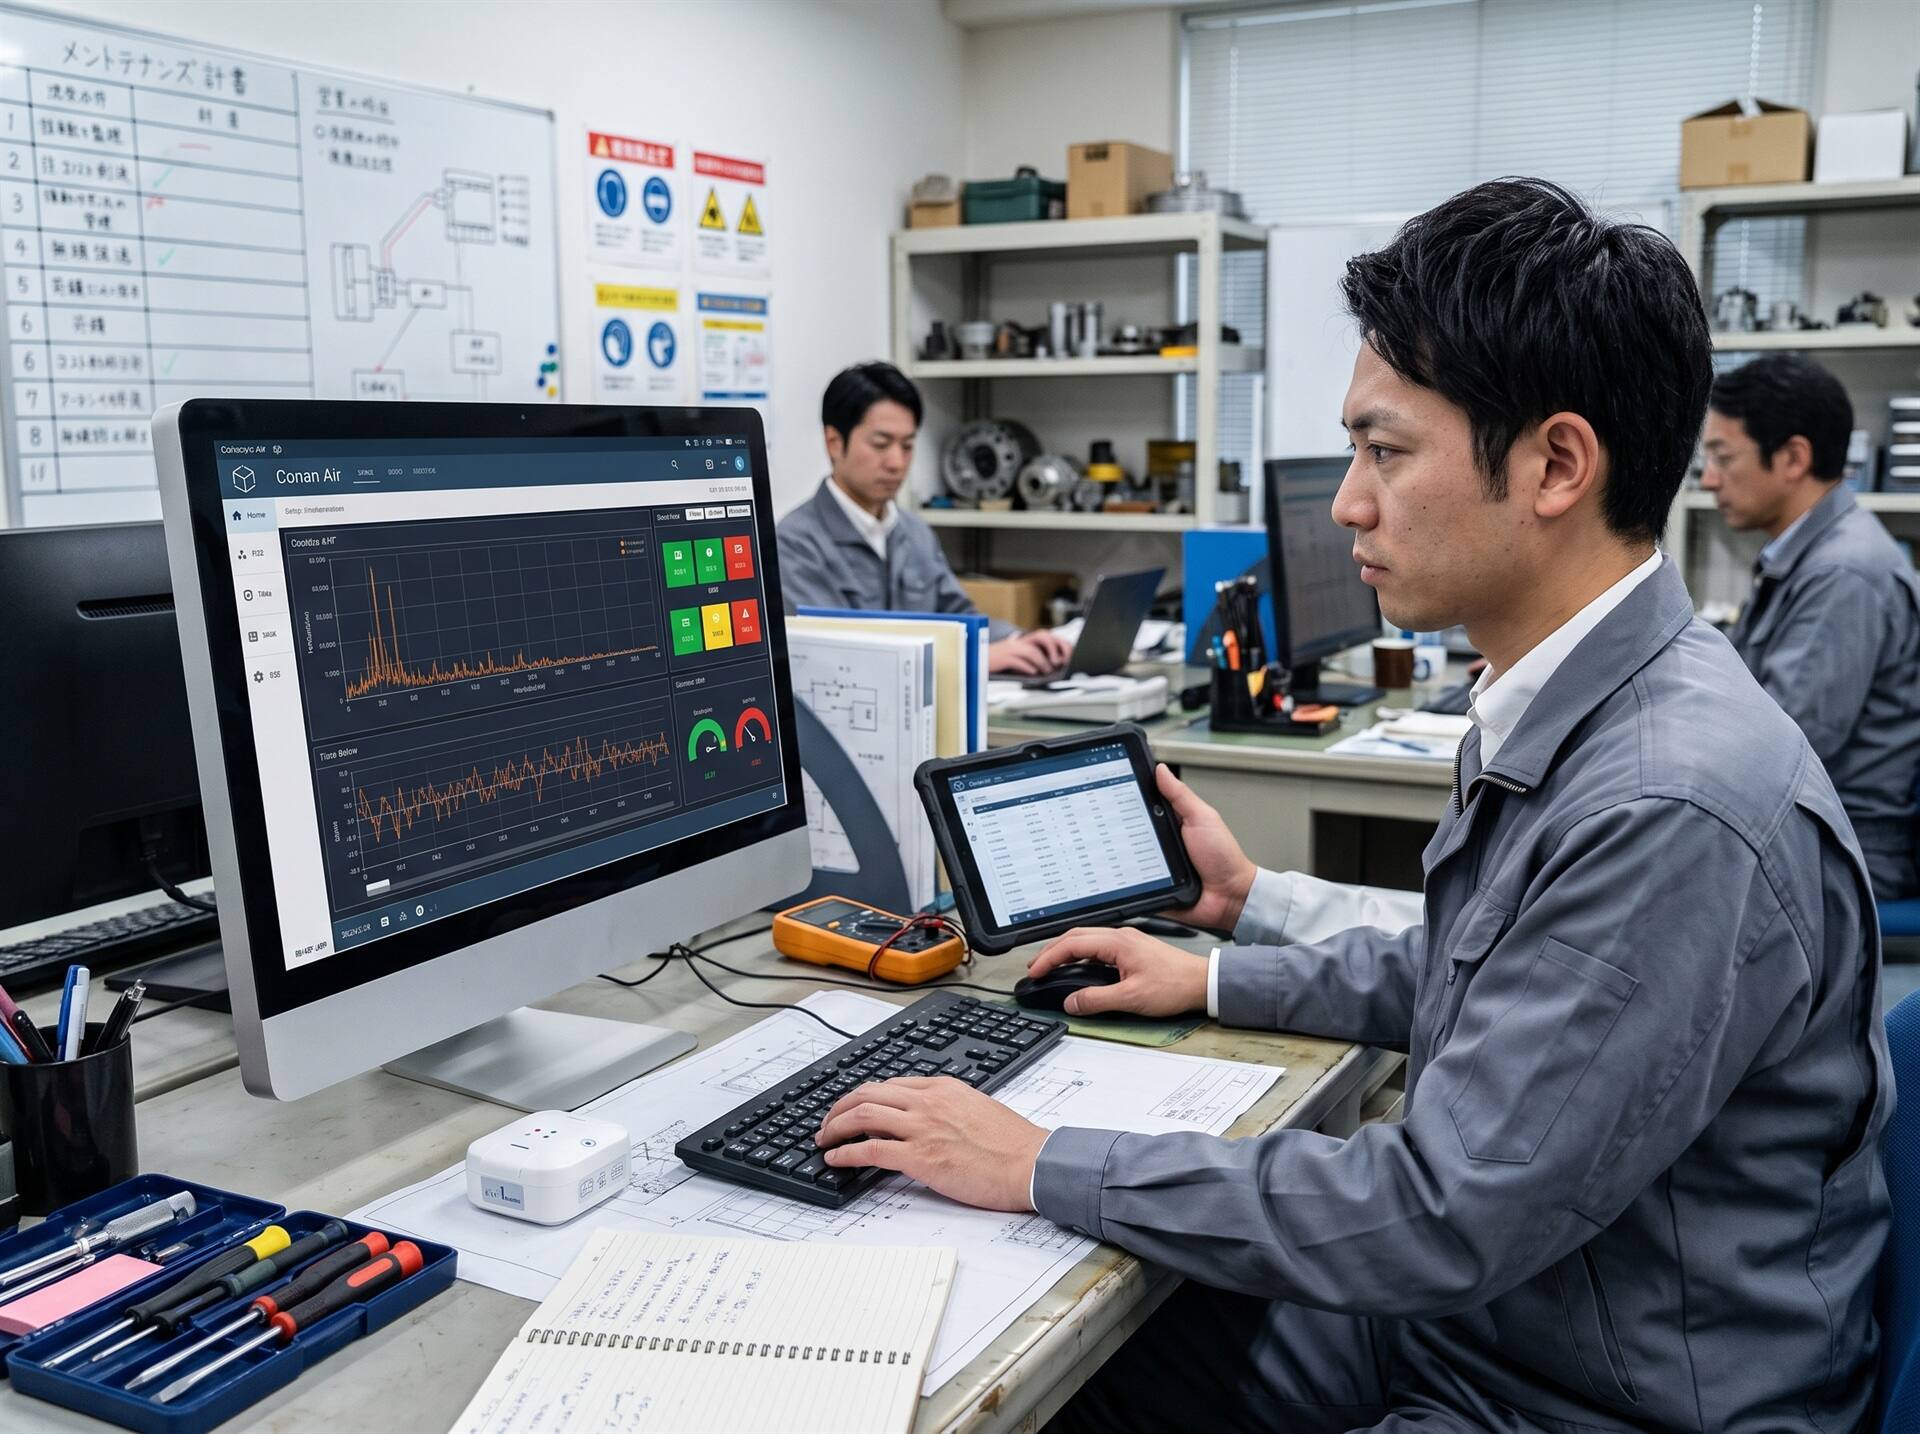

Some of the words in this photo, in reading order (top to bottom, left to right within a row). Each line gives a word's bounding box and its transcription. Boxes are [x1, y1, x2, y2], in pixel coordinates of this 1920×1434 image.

[10, 152, 20, 170] 2
[13, 194, 23, 213] 3
[18, 278, 28, 294] 5
[21, 315, 32, 333] 6
[24, 353, 35, 372] 6
[26, 389, 38, 408] 7
[30, 427, 40, 447] 8
[277, 469, 320, 484] Conan
[324, 468, 342, 482] Air
[247, 511, 266, 519] Home
